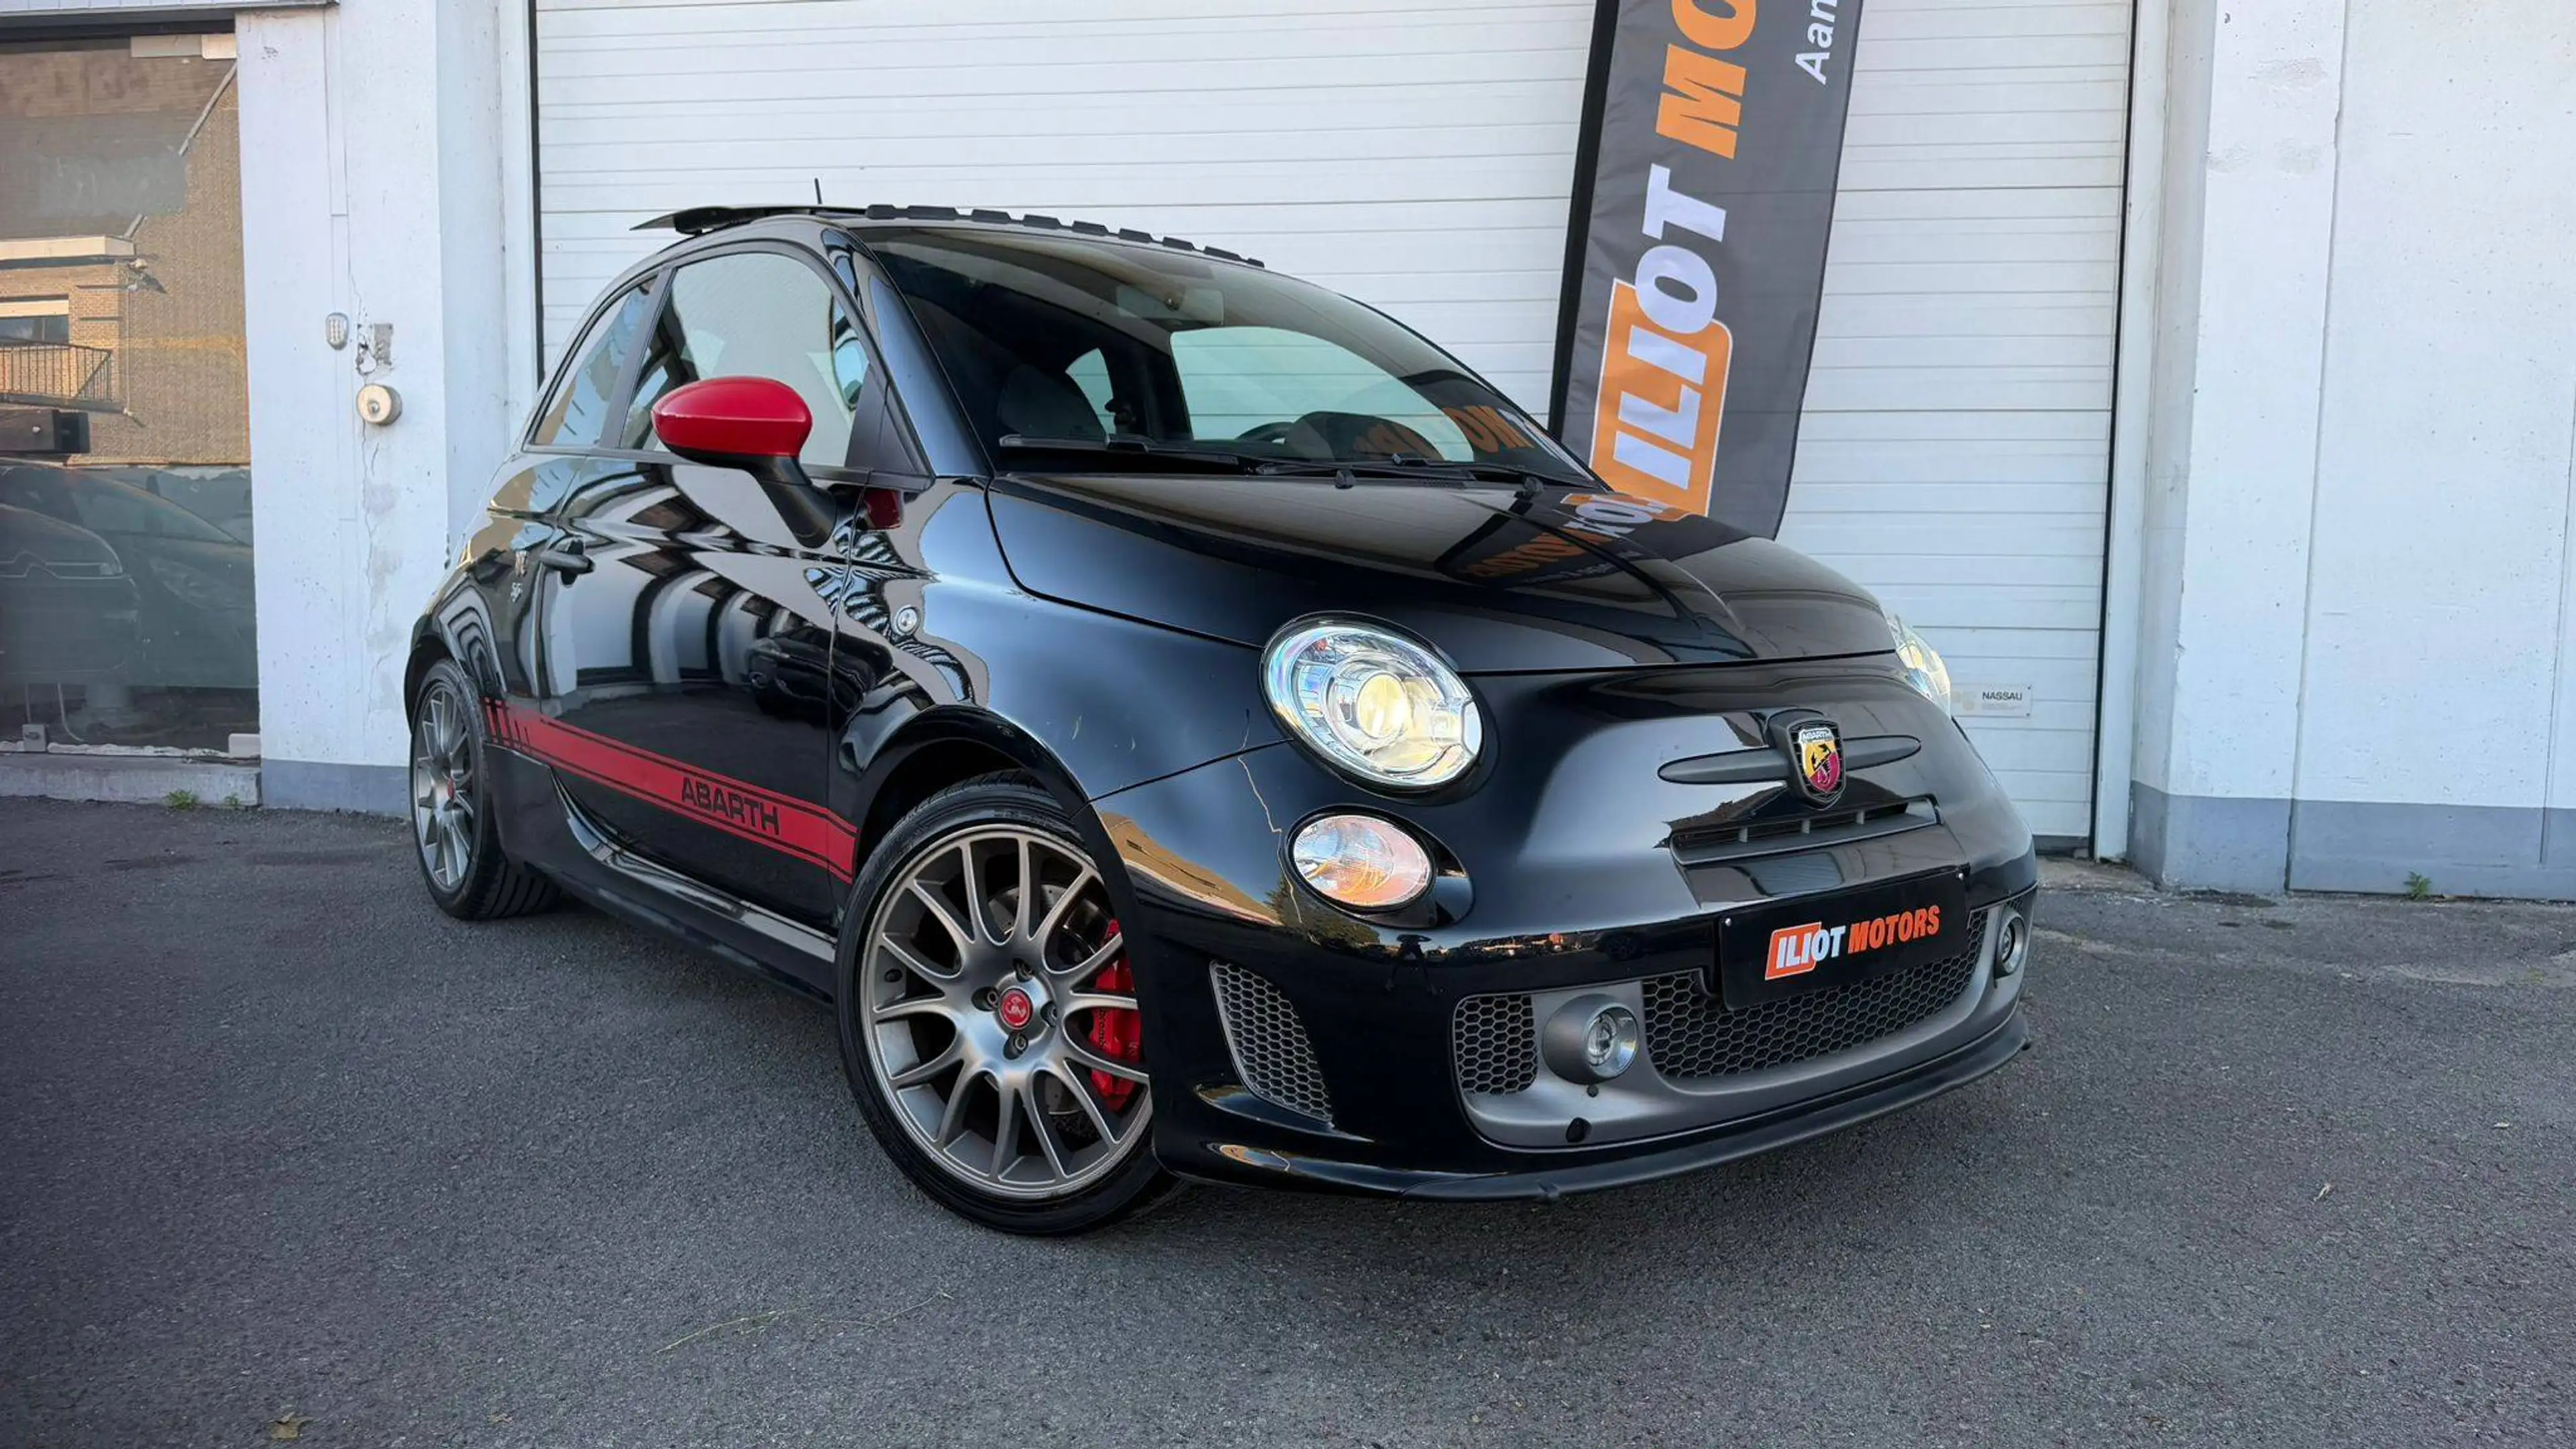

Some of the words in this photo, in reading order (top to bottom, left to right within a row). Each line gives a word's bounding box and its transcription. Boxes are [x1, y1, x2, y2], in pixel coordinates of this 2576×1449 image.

[1613, 162, 1727, 490] ILIOT
[1982, 691, 2023, 701] NASSAU
[682, 776, 780, 835] ABARTH
[1776, 925, 1846, 969] ILIOT
[1847, 904, 1940, 954] MOTORS
